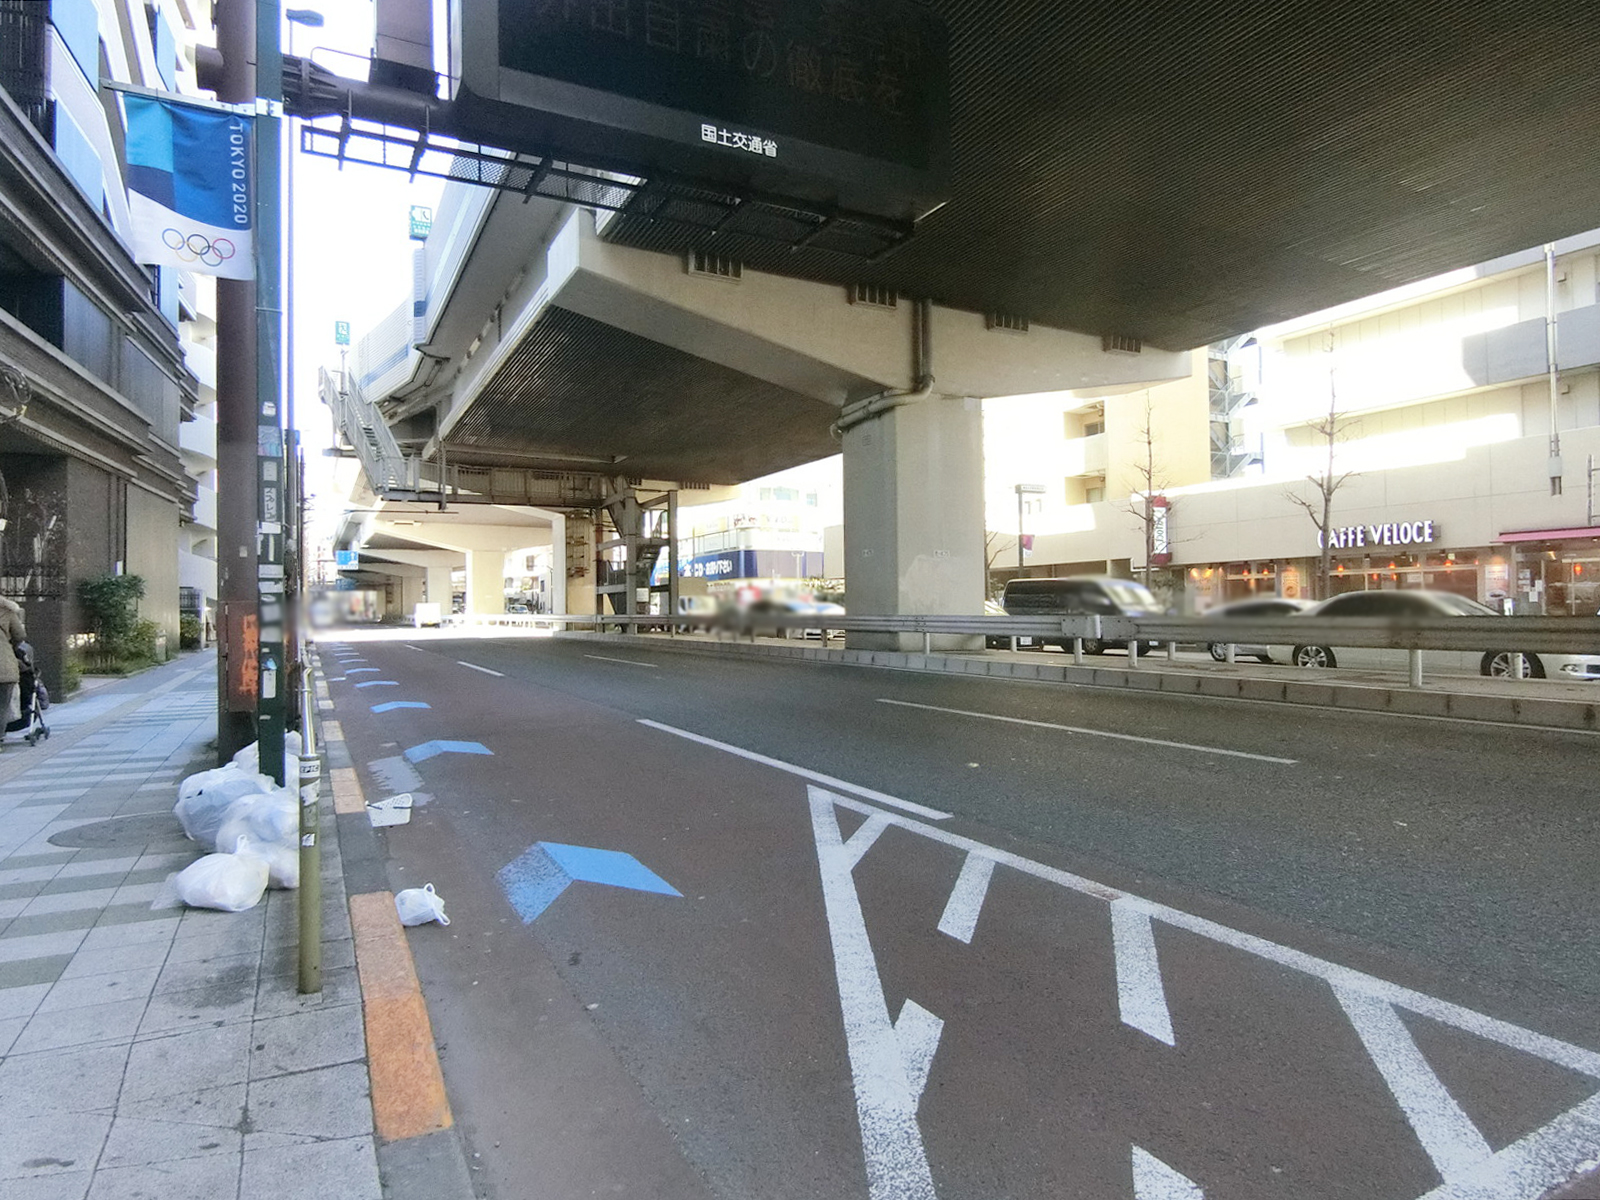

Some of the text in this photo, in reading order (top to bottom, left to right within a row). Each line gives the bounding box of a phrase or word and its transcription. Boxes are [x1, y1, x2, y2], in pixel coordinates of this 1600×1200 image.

[701, 123, 778, 158] 国土交通省
[229, 123, 248, 224] TOKYO 2020
[1369, 520, 1434, 545] VELOCE
